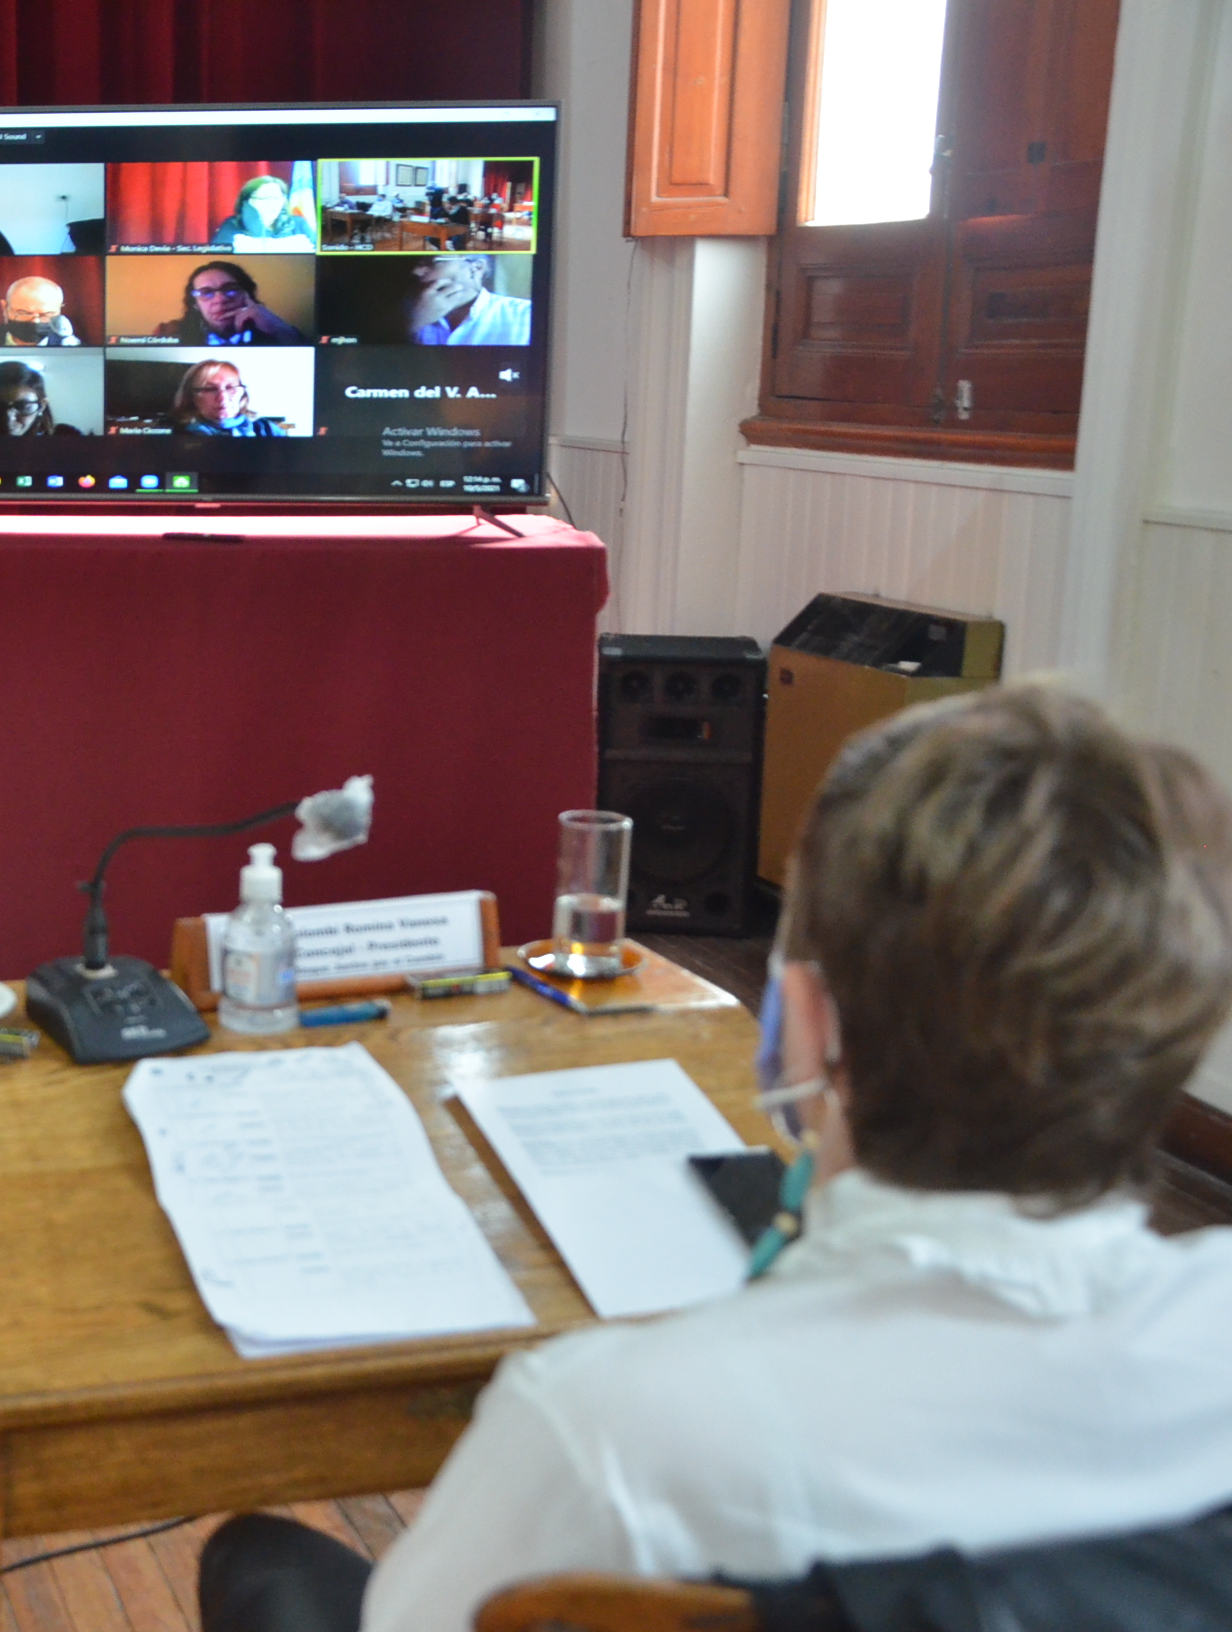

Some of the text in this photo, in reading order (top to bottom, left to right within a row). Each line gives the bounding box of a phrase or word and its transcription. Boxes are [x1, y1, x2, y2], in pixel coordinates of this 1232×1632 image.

[344, 386, 497, 398] Carmen del V. A...
[382, 427, 481, 436] Activar Windows
